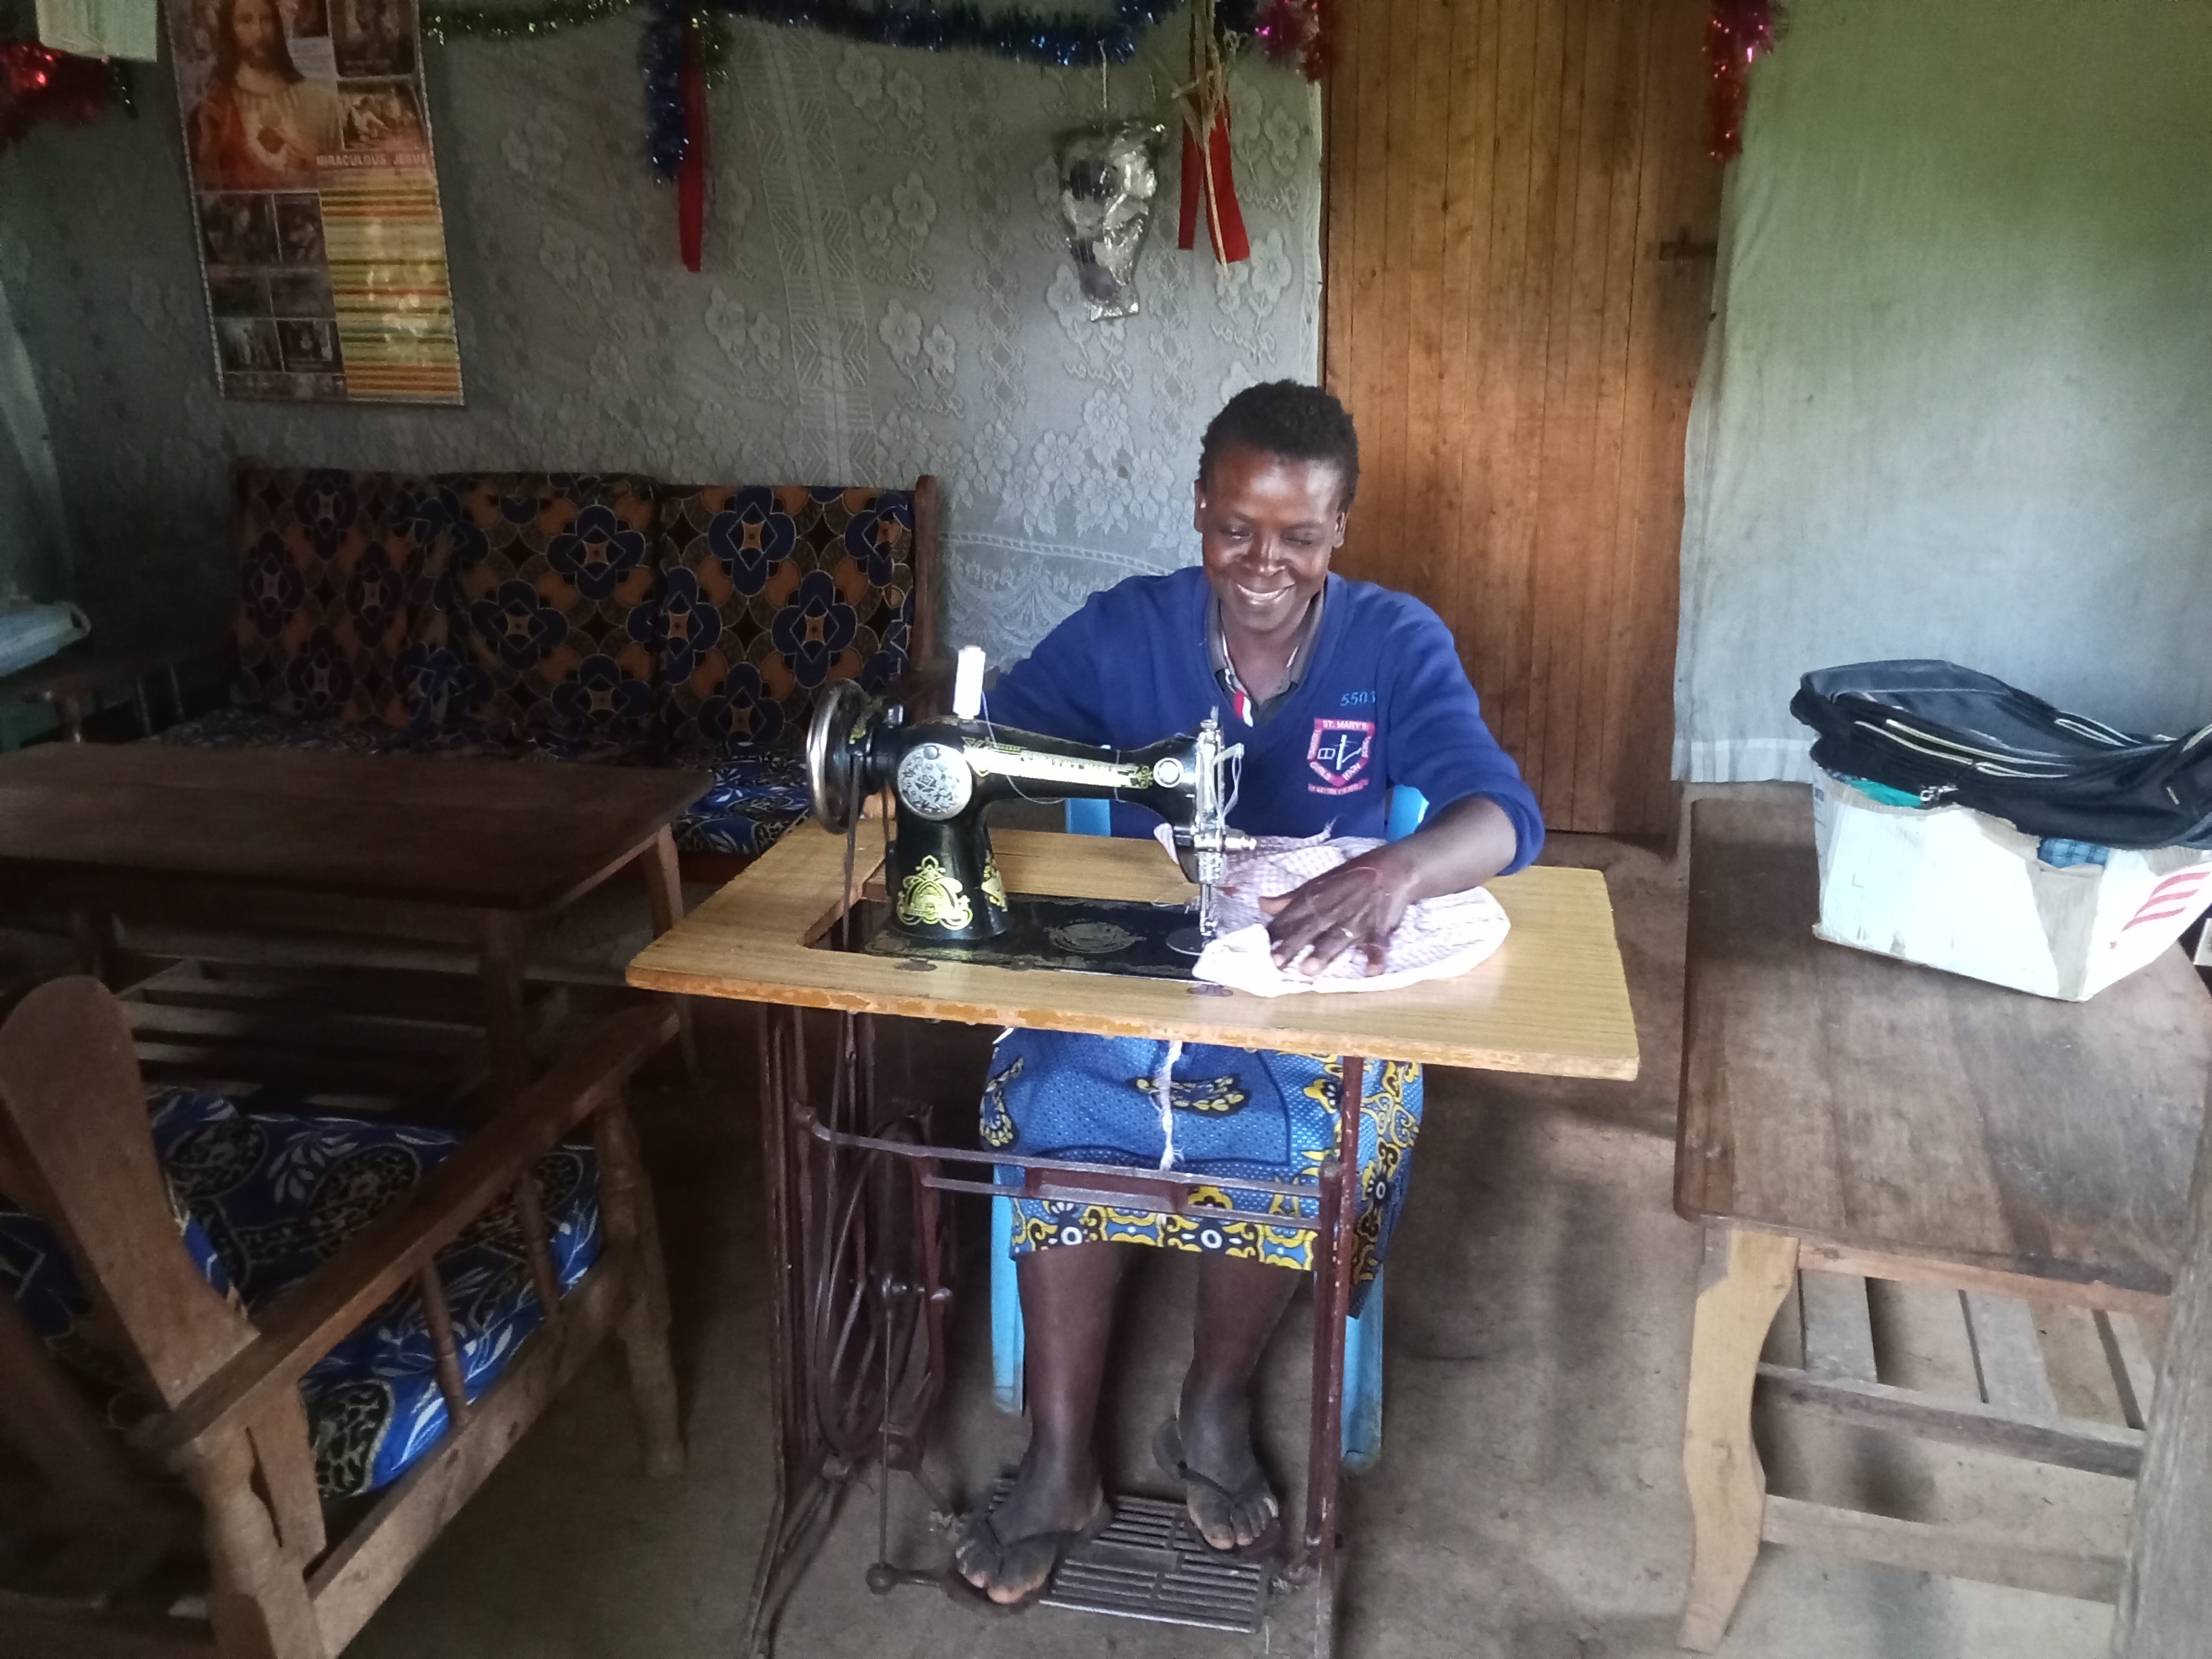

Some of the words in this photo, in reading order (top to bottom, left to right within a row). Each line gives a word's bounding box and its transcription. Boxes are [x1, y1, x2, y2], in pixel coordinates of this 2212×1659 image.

[316, 154, 386, 166] MIRACULOUS
[393, 153, 427, 165] JESUS
[1310, 761, 1332, 781] GIRLS
